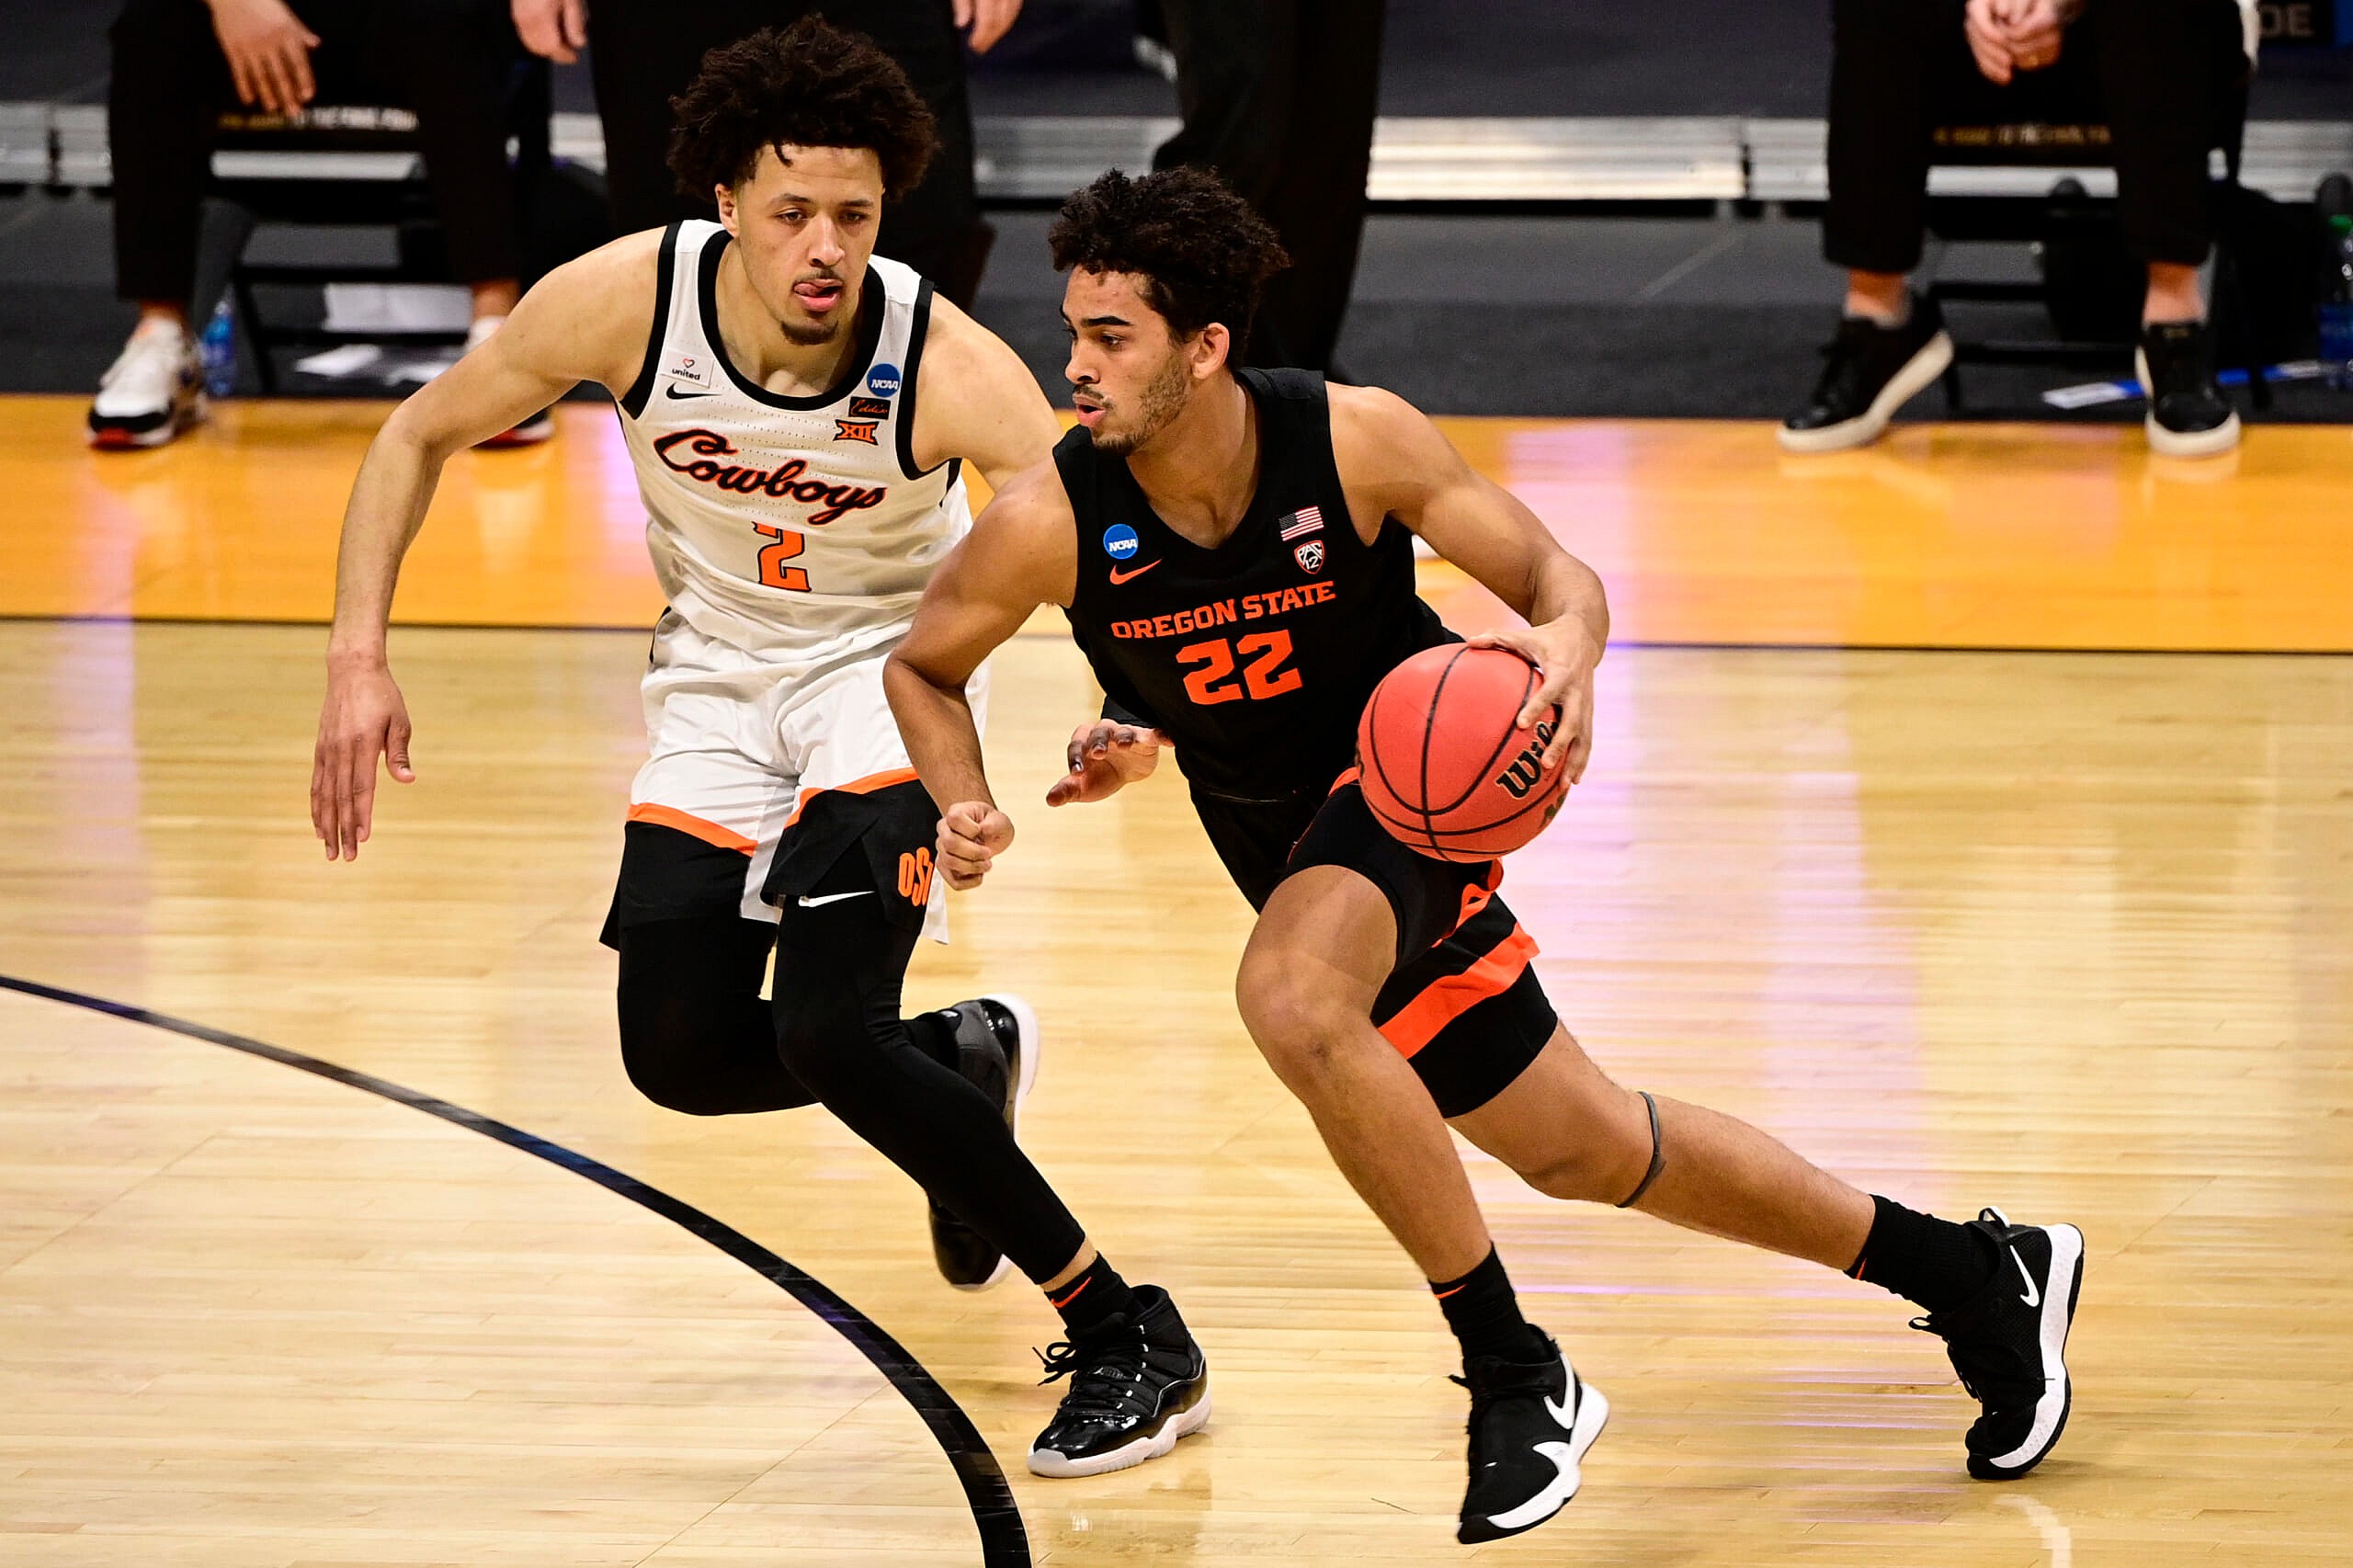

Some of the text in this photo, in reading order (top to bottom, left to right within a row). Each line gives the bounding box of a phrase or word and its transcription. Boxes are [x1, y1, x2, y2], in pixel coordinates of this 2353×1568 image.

[672, 368, 700, 381] united
[870, 379, 899, 390] NCAA
[837, 422, 876, 442] XII
[654, 428, 888, 526] Cowboys
[752, 521, 812, 593] 2
[1108, 539, 1138, 552] NCAA
[1297, 542, 1323, 565] PAC
[1305, 556, 1320, 570] 12
[1110, 580, 1336, 639] OREGON STATE
[1176, 629, 1303, 705] 22
[1495, 721, 1561, 799] Wil
